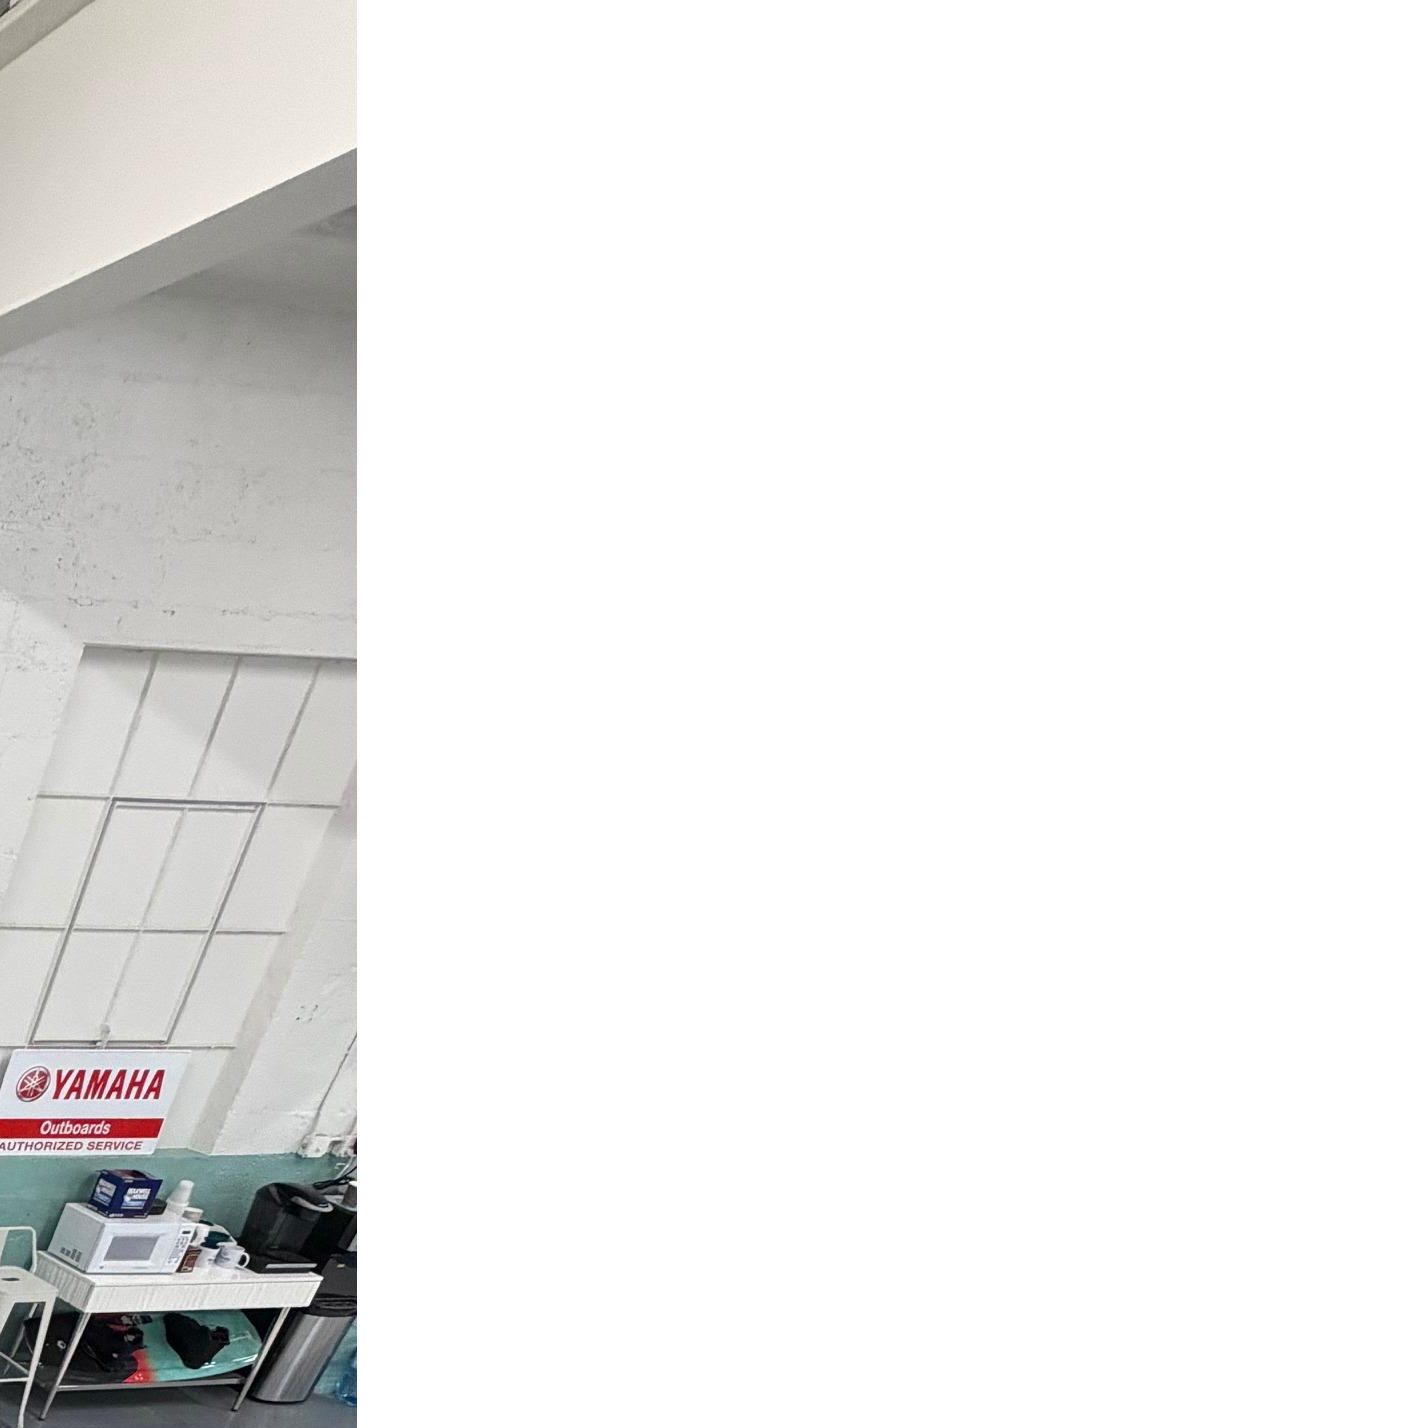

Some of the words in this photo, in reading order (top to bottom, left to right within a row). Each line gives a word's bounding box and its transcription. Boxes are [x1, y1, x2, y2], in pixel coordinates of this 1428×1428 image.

[52, 1069, 166, 1100] YAMAHA
[39, 1120, 112, 1136] Outboards
[86, 1140, 144, 1151] SERVICE
